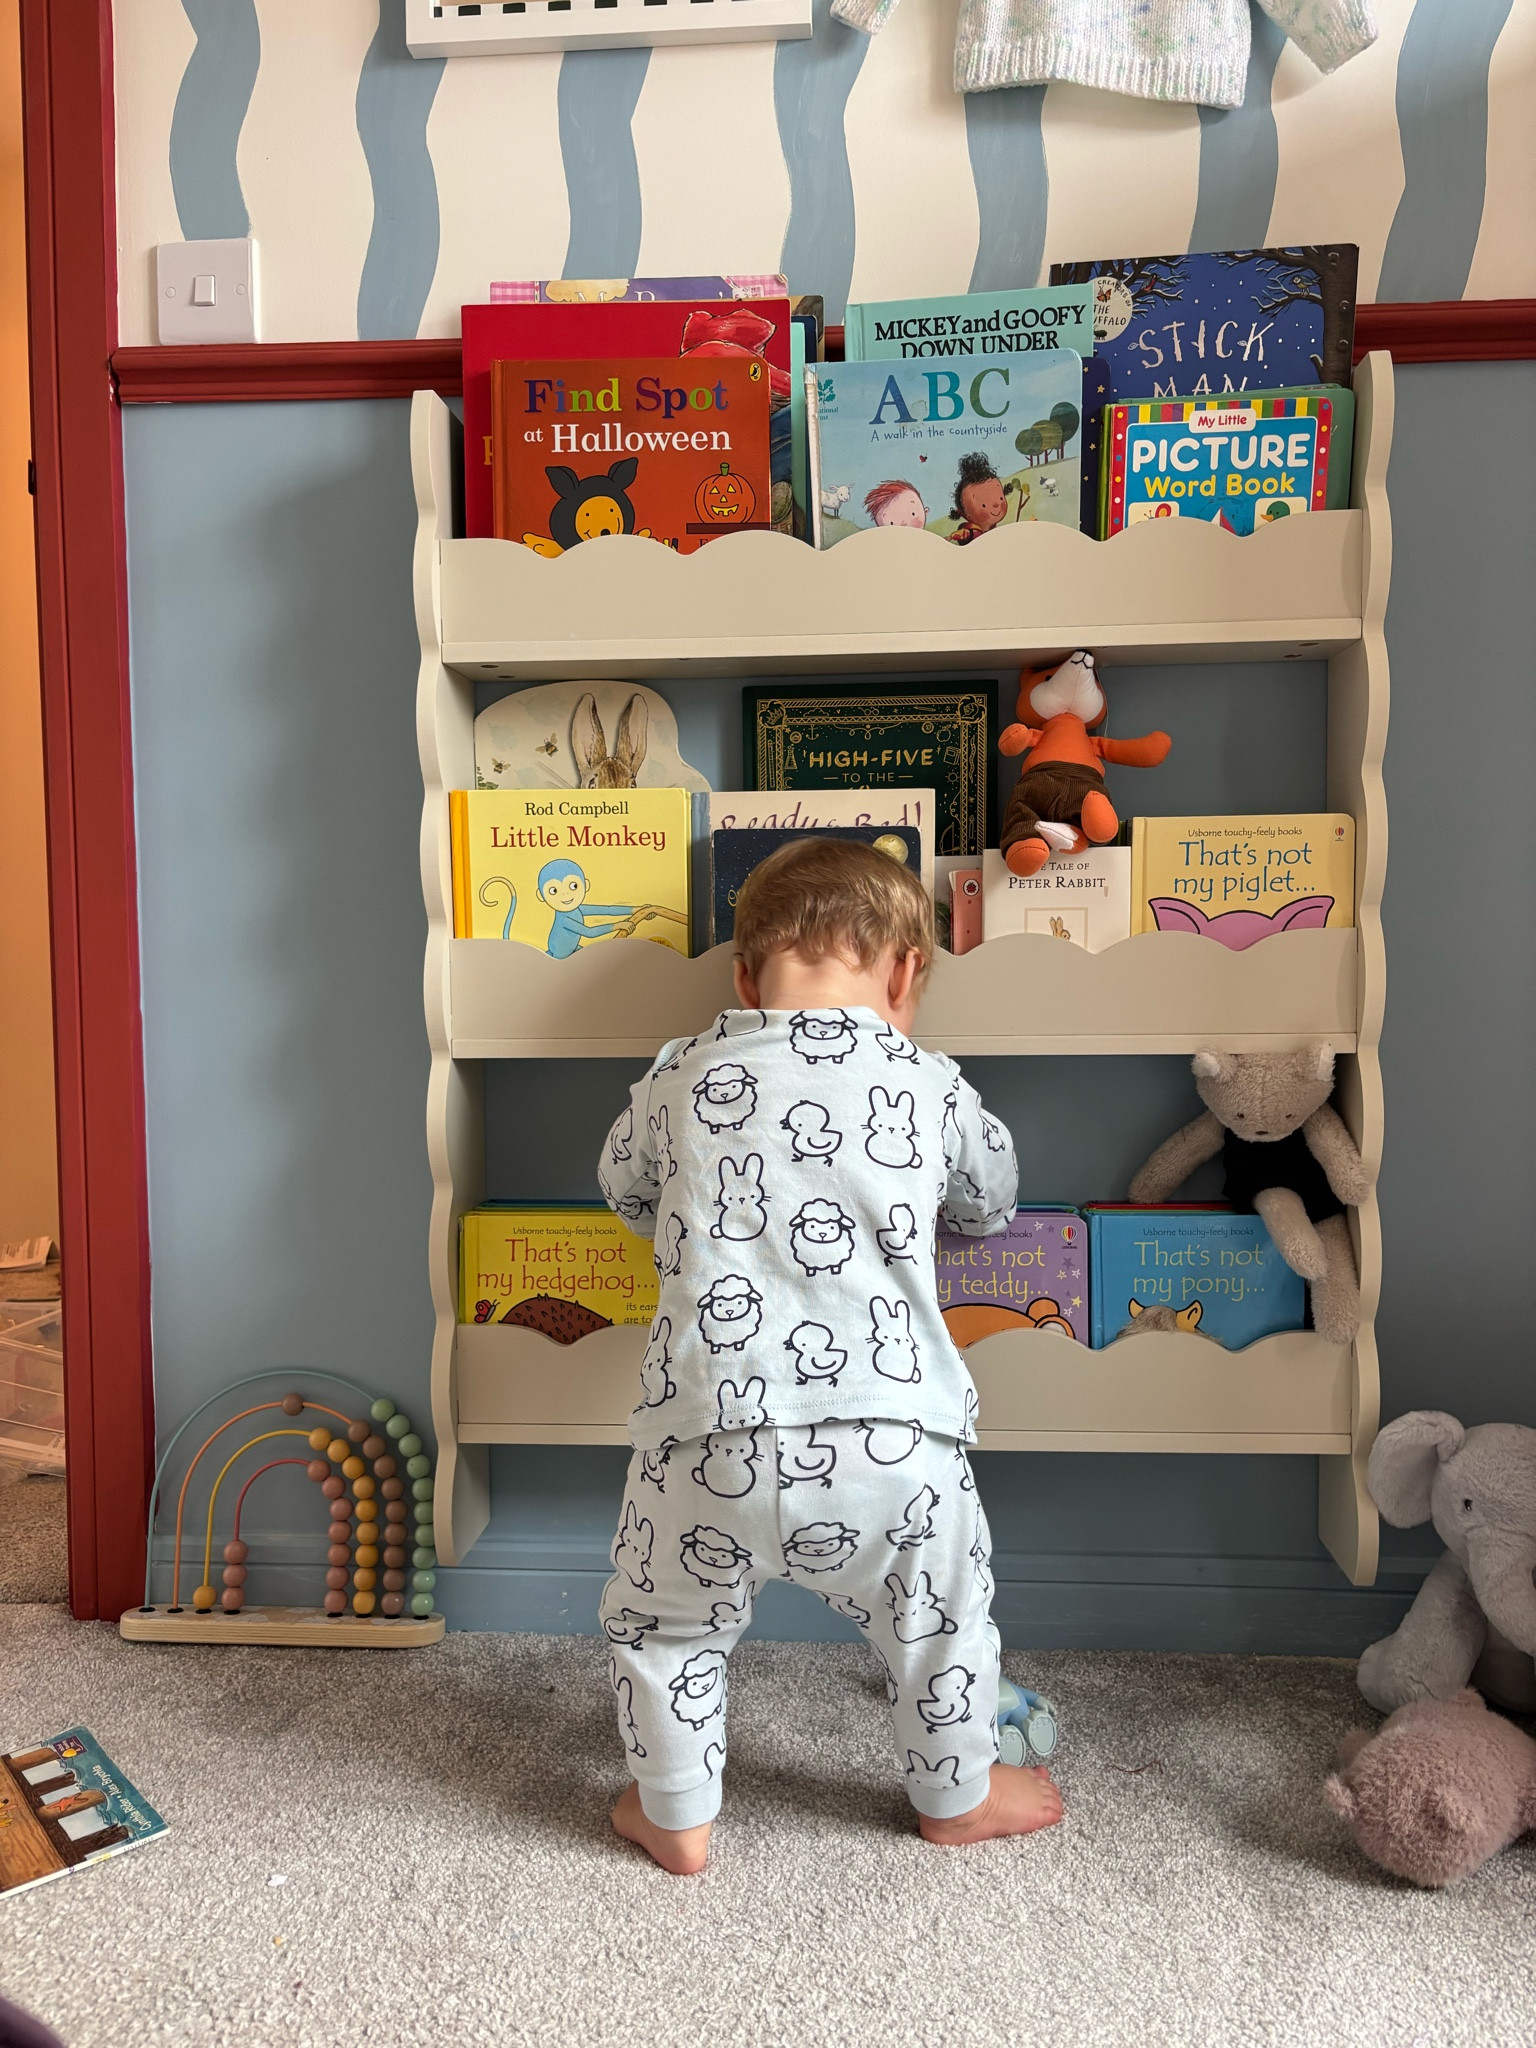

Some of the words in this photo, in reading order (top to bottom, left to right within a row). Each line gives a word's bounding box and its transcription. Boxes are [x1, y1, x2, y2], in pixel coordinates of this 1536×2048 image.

[1093, 304, 1110, 314] THE
[1093, 316, 1127, 326] FFALO
[874, 315, 961, 341] MICKEY
[962, 309, 1001, 334] and
[1004, 304, 1087, 330] GOOFY
[901, 337, 975, 359] DOWN
[981, 330, 1059, 353] UNDER
[1139, 319, 1274, 369] STICK
[524, 378, 622, 413] Find
[635, 377, 728, 418] Spot
[869, 367, 1011, 425] ABC
[818, 406, 839, 414] ational
[1197, 415, 1215, 428] My
[1218, 414, 1247, 426] Little
[523, 427, 543, 443] at
[551, 423, 732, 453] Halloween
[870, 430, 880, 443] A
[884, 426, 909, 440] walk
[912, 427, 923, 439] in
[927, 425, 945, 438] the
[949, 423, 1008, 440] countryside
[1132, 433, 1311, 473] PICTURE
[1144, 474, 1216, 498] Word
[1226, 472, 1295, 496] Book
[808, 748, 934, 768] HIGH-FIVE
[842, 772, 861, 783] TO
[868, 772, 895, 782] THE
[524, 802, 554, 816] Rod
[559, 801, 629, 818] Campbell
[490, 826, 559, 848] Little
[567, 825, 666, 852] Monkey
[1188, 828, 1222, 837] Usborne
[1224, 826, 1276, 838] touchy-feely
[1277, 827, 1303, 836] books
[1178, 840, 1257, 866] That's
[1267, 842, 1313, 866] not
[1049, 862, 1074, 871] TALE
[1077, 863, 1090, 871] OF
[1008, 876, 1051, 889] PETER
[1056, 876, 1106, 888] RABBIT
[1174, 877, 1214, 902] my
[1223, 865, 1315, 901] piglet...
[513, 1227, 544, 1236] Usborne
[546, 1226, 593, 1237] touchy-feely
[594, 1227, 617, 1235] books
[1009, 1230, 1033, 1239] books
[1143, 1228, 1176, 1236] Usborne
[1178, 1227, 1228, 1238] touchy-feely
[1230, 1227, 1254, 1236] books
[504, 1237, 577, 1263] That's
[586, 1242, 627, 1264] not
[937, 1240, 992, 1267] hat's
[1002, 1244, 1046, 1268] not
[1133, 1240, 1210, 1267] That's
[1220, 1243, 1263, 1267] not
[477, 1272, 513, 1297] my
[522, 1265, 655, 1298] hedgehog...
[938, 1278, 951, 1303] y
[959, 1271, 1049, 1304] teddy...
[1133, 1277, 1172, 1302] my
[1181, 1276, 1265, 1302] pony...
[626, 1302, 637, 1311] its
[639, 1303, 659, 1311] ears
[623, 1316, 639, 1324] are
